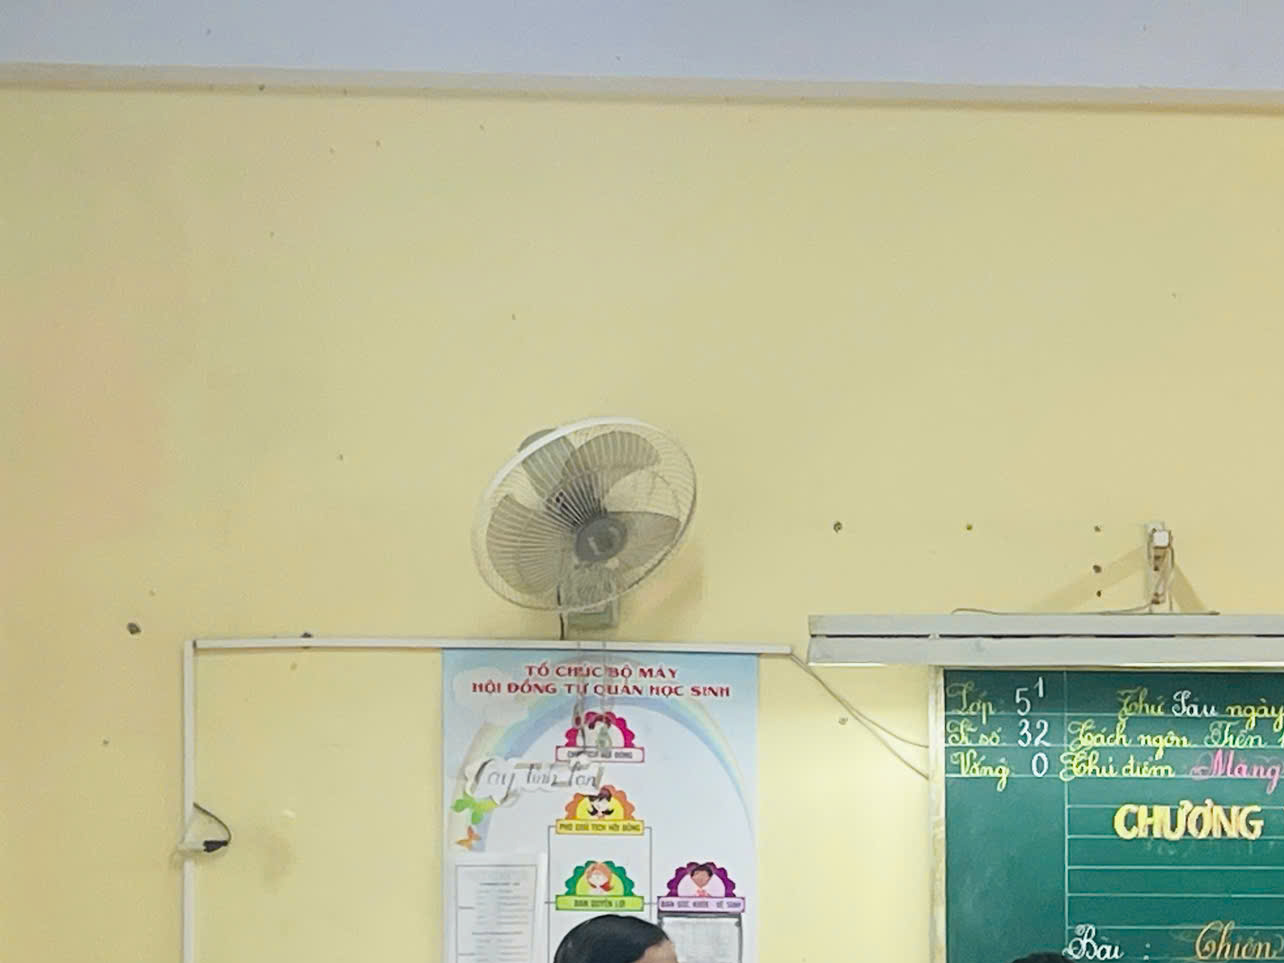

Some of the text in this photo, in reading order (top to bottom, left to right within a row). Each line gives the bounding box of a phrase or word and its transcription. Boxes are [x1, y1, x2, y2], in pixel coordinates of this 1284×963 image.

[639, 666, 678, 679] MÁY
[472, 682, 501, 697] HỘI
[507, 679, 557, 695] ĐỒNG
[650, 684, 684, 698] HỌC
[691, 685, 730, 698] SINH
[1018, 719, 1051, 747] 32
[1031, 752, 1049, 777] 0
[1113, 798, 1264, 841] CHƯƠNG
